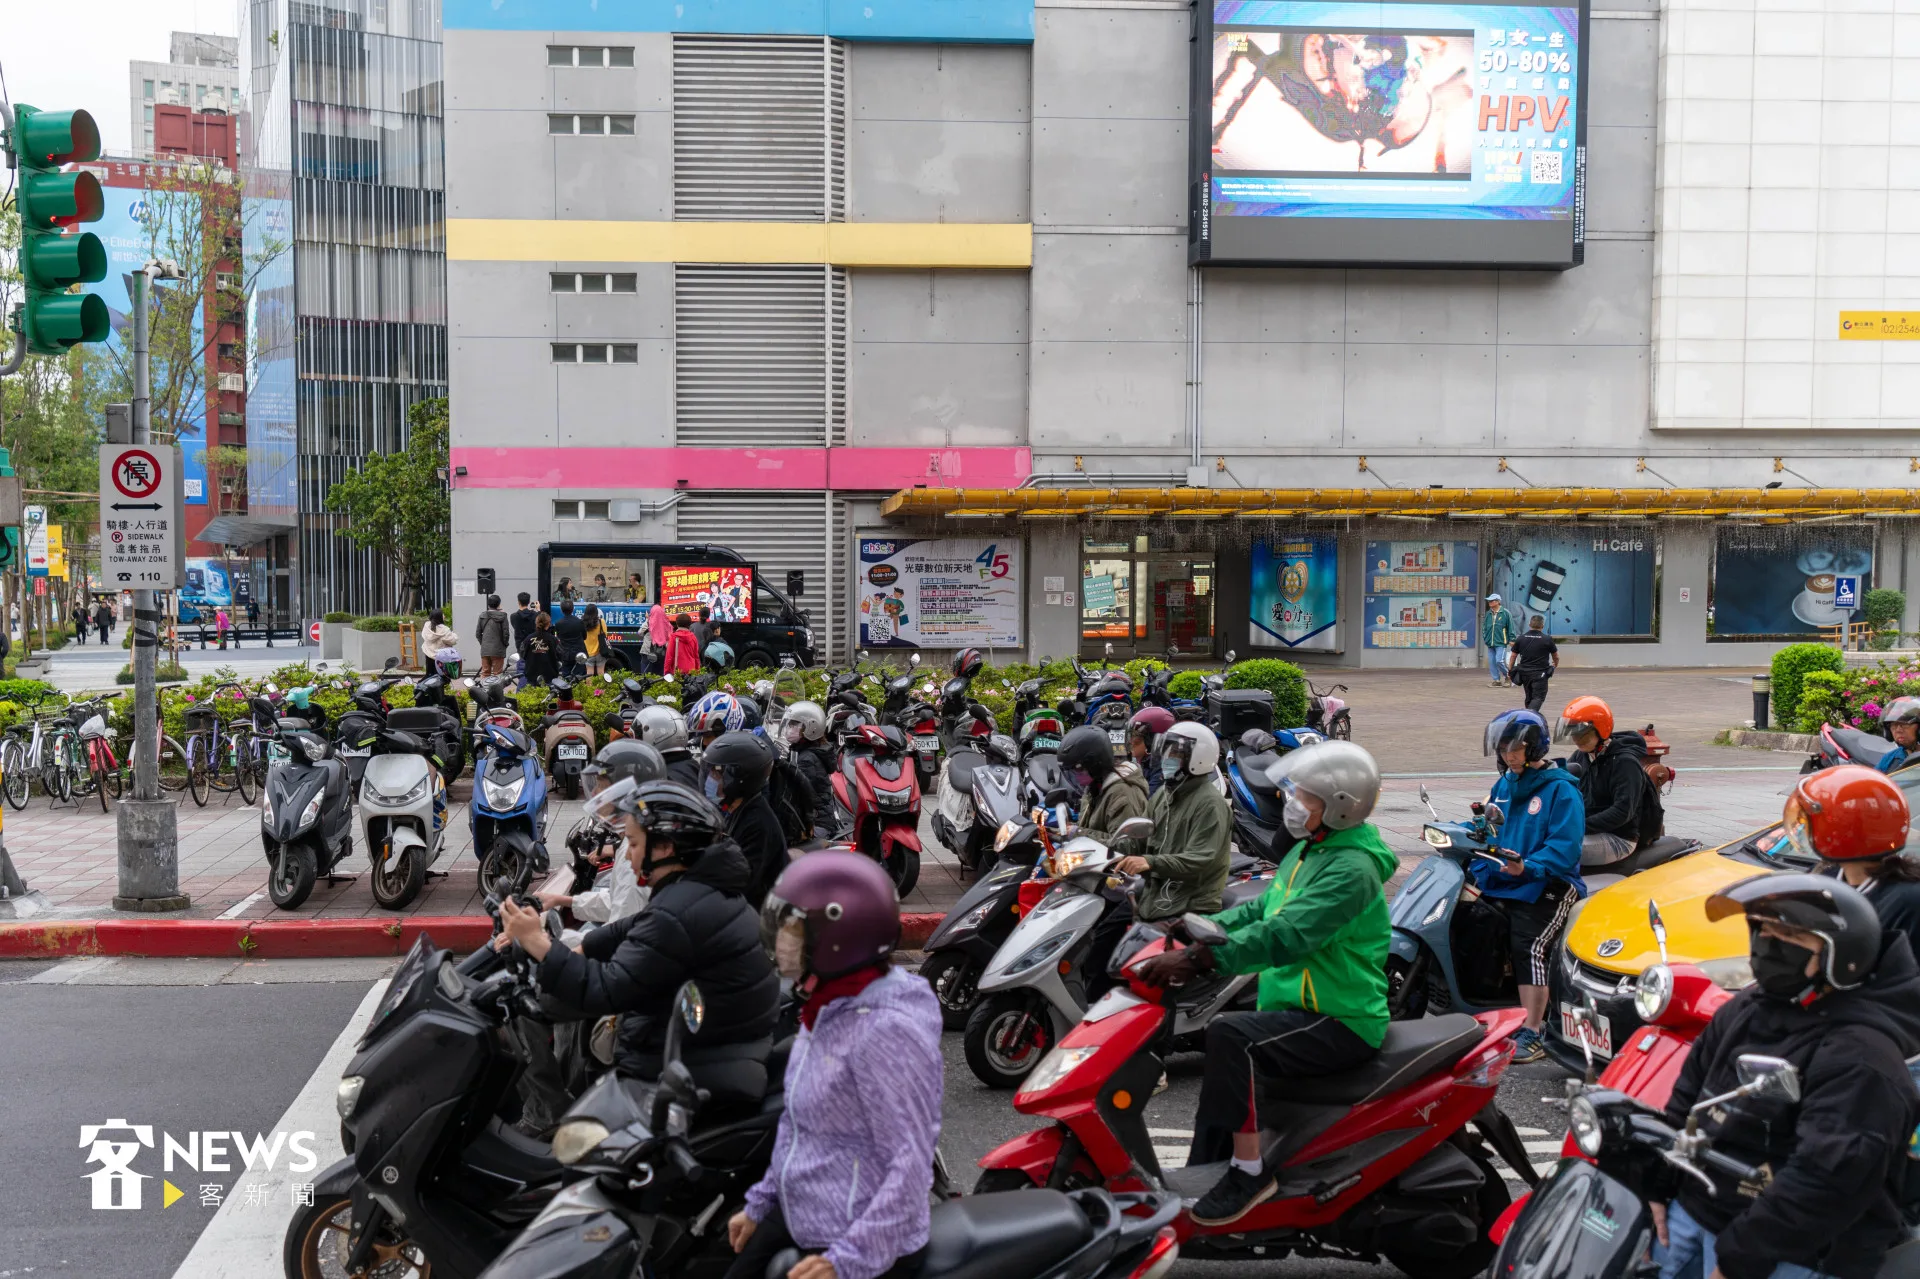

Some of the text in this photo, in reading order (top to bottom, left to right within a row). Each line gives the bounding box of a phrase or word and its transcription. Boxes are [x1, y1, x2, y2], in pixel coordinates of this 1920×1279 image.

[1488, 28, 1565, 48] 男女一生
[1478, 50, 1571, 73] 50-80%
[1478, 94, 1570, 132] HPV
[123, 461, 149, 487] 停
[115, 543, 161, 554] 違者拖吊
[1593, 539, 1643, 551] Hi Café
[905, 563, 973, 574] 光華數位新天地
[991, 554, 1009, 578] 5
[139, 572, 161, 581] 110
